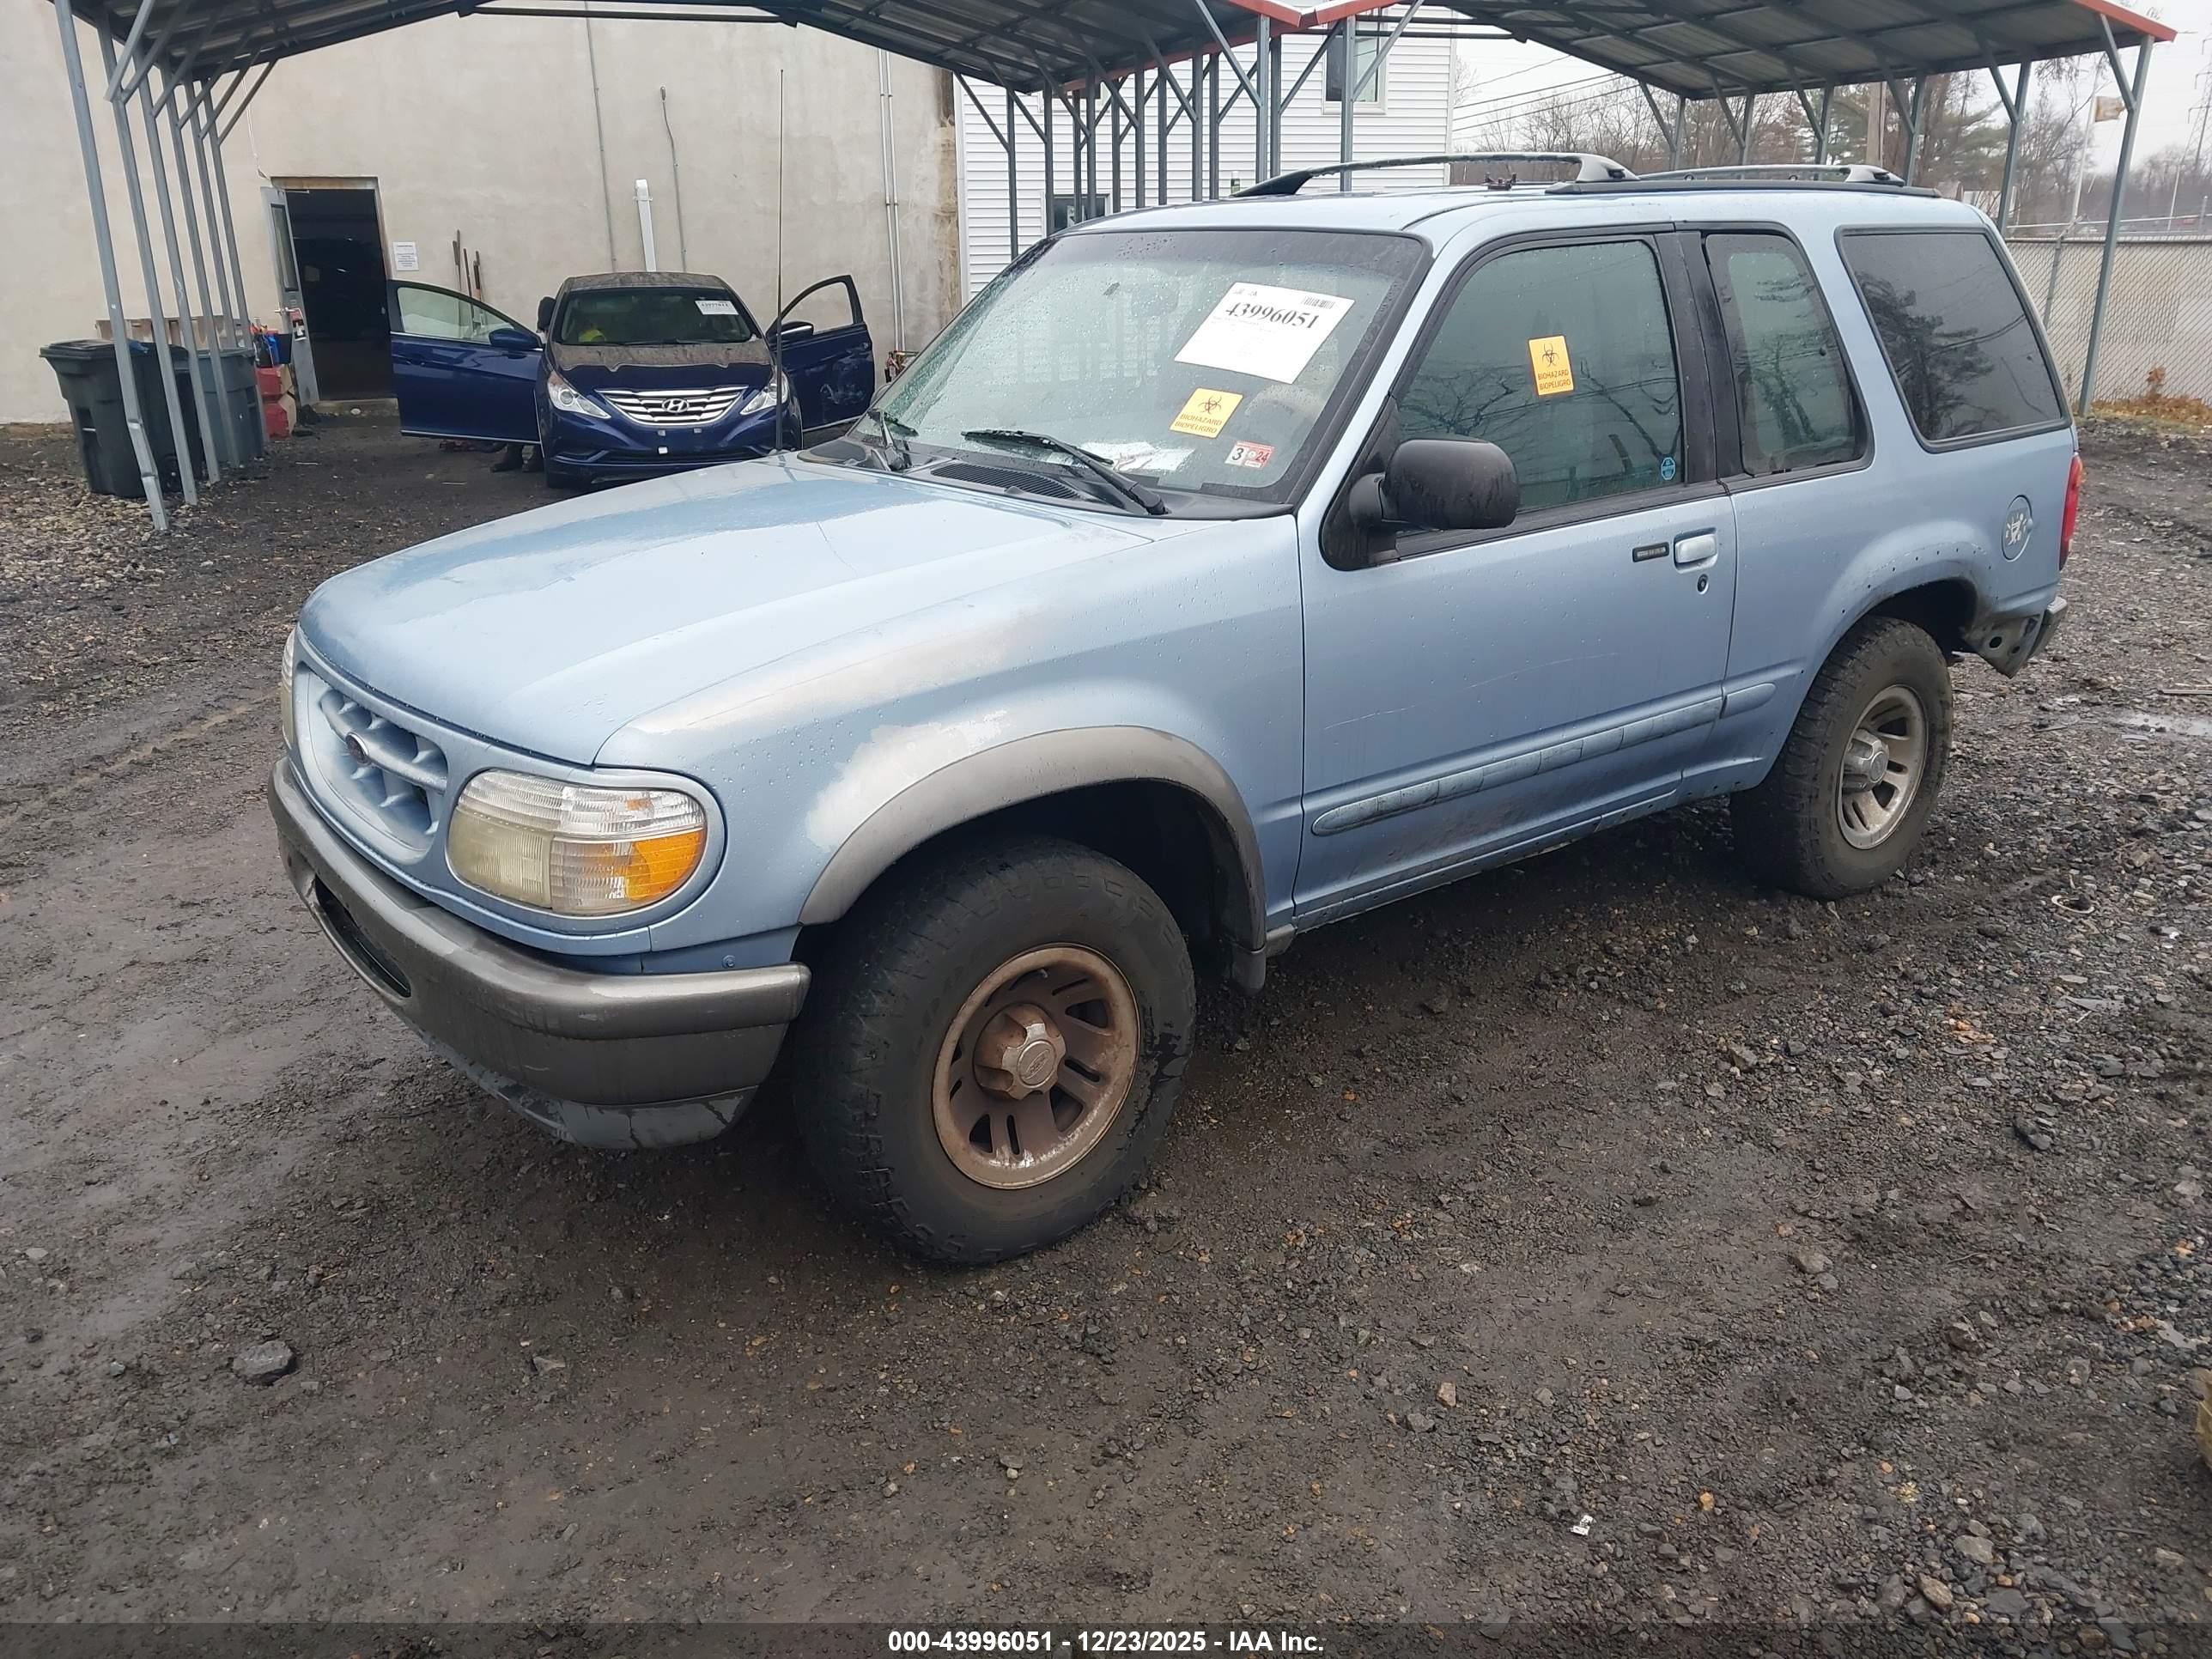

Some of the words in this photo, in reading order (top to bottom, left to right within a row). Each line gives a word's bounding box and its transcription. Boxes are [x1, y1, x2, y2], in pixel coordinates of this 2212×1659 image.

[1225, 301, 1320, 329] 43996051
[1537, 369, 1569, 380] BIOHAZARD
[1539, 379, 1571, 391] BIOPELIGRO
[1180, 413, 1223, 426] BIOHAZARD
[1175, 421, 1218, 434] BIOPELIGRO
[1231, 447, 1244, 461] 3
[1255, 451, 1270, 463] 24
